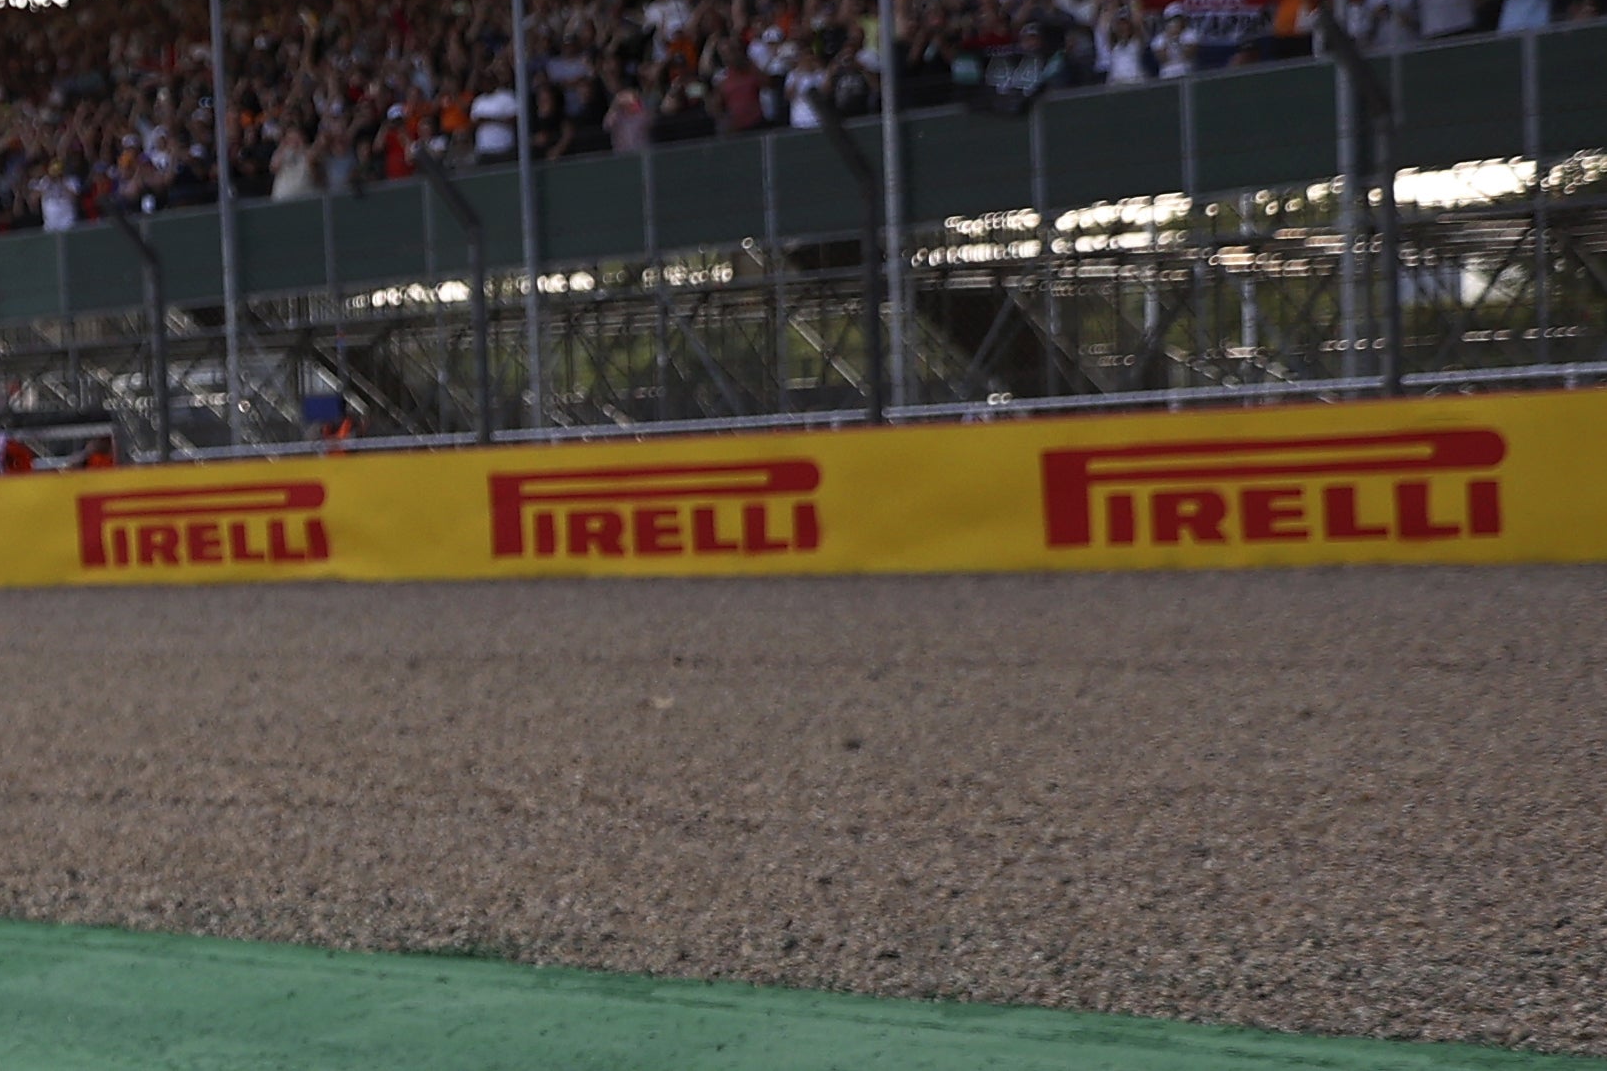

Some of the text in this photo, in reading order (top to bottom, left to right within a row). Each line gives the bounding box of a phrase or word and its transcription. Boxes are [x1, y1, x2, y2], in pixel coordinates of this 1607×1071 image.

[76, 482, 331, 567] PIRELLI
[489, 458, 823, 559] PIRELLI
[1041, 429, 1508, 549] PIRELLI
